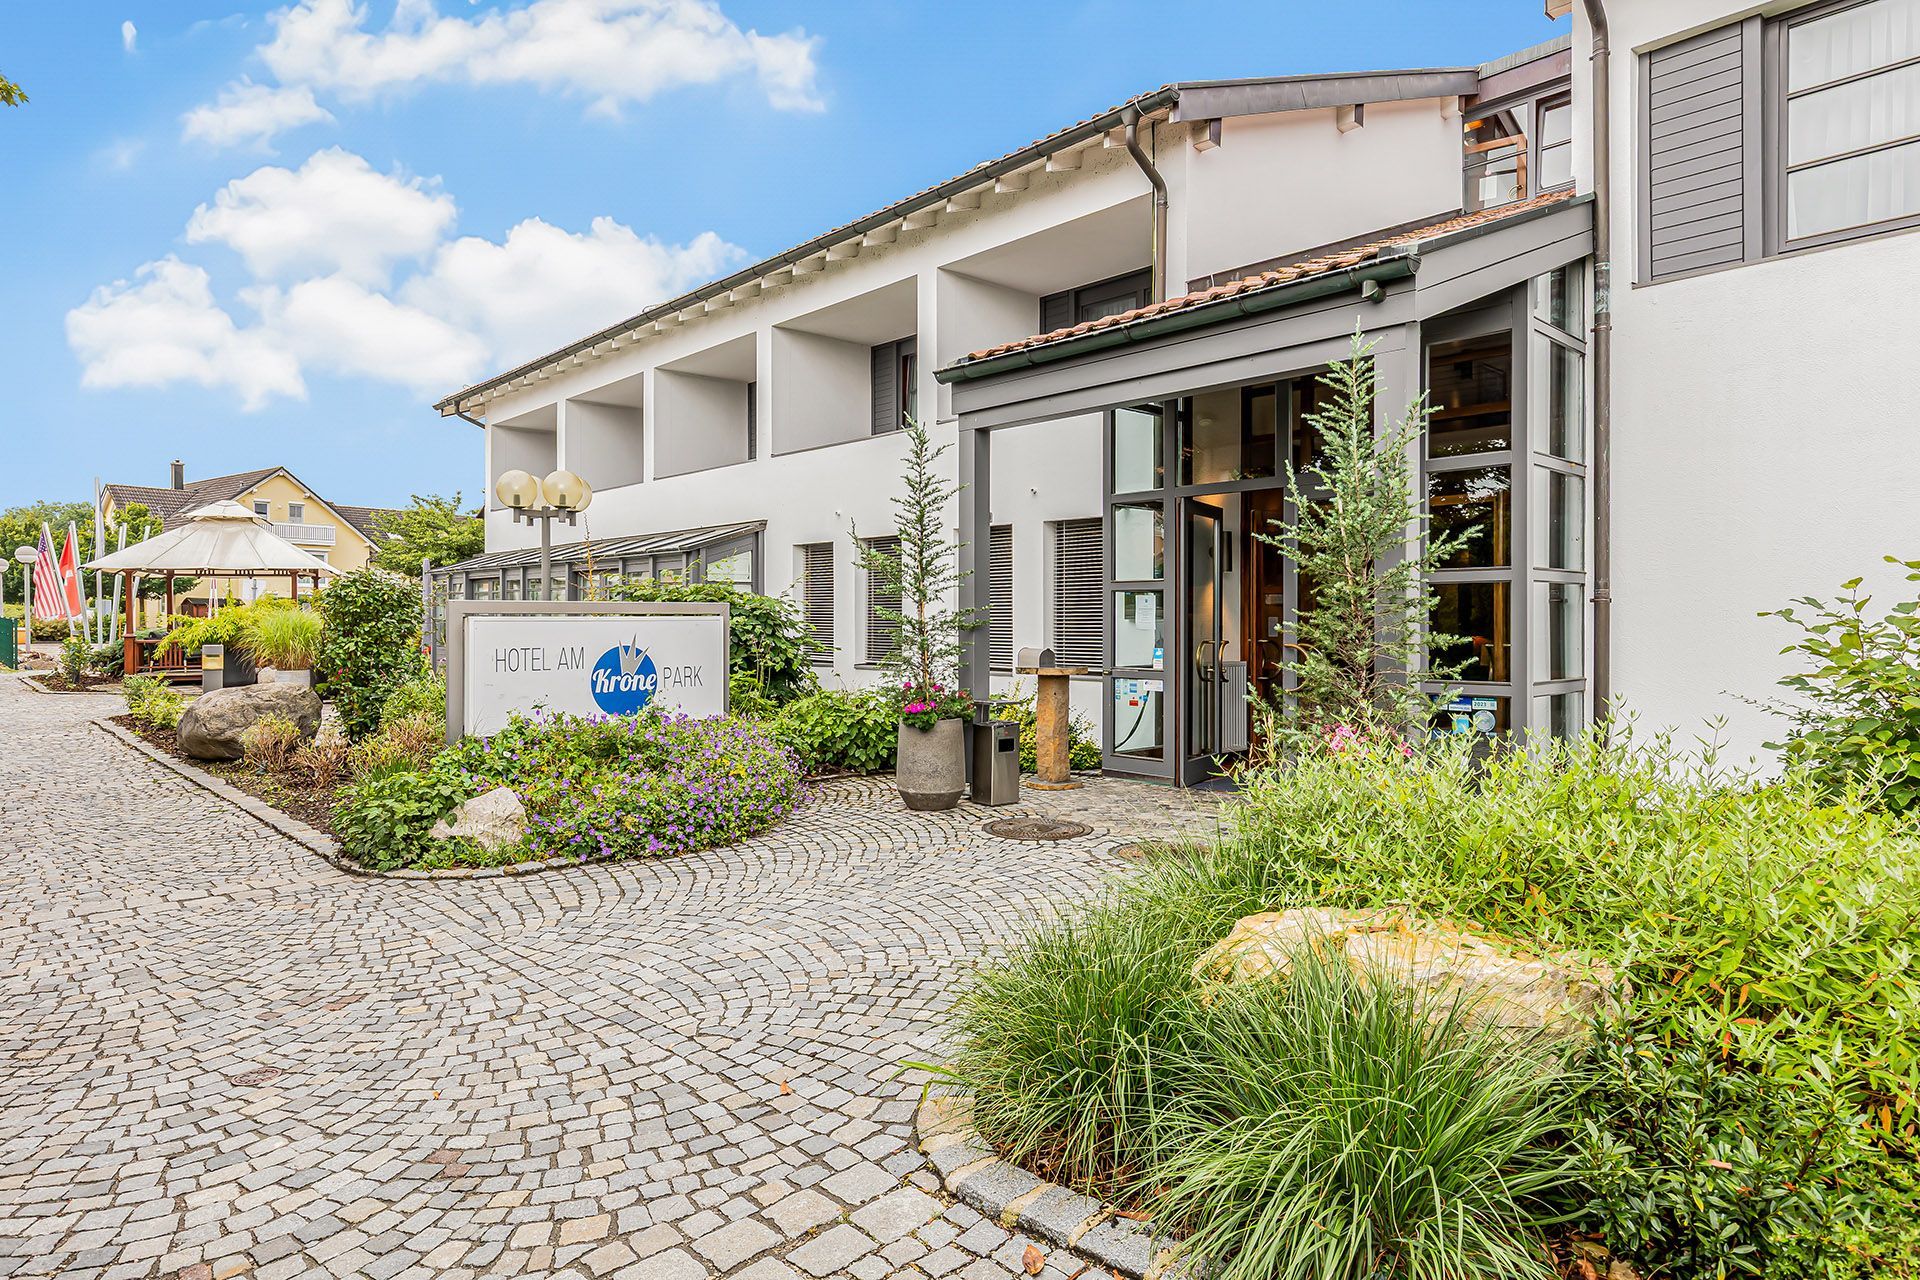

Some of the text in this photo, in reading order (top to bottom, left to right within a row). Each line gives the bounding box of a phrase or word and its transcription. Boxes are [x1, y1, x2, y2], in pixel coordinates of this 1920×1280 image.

[495, 646, 703, 693] HOTEL AM Krone PARK
